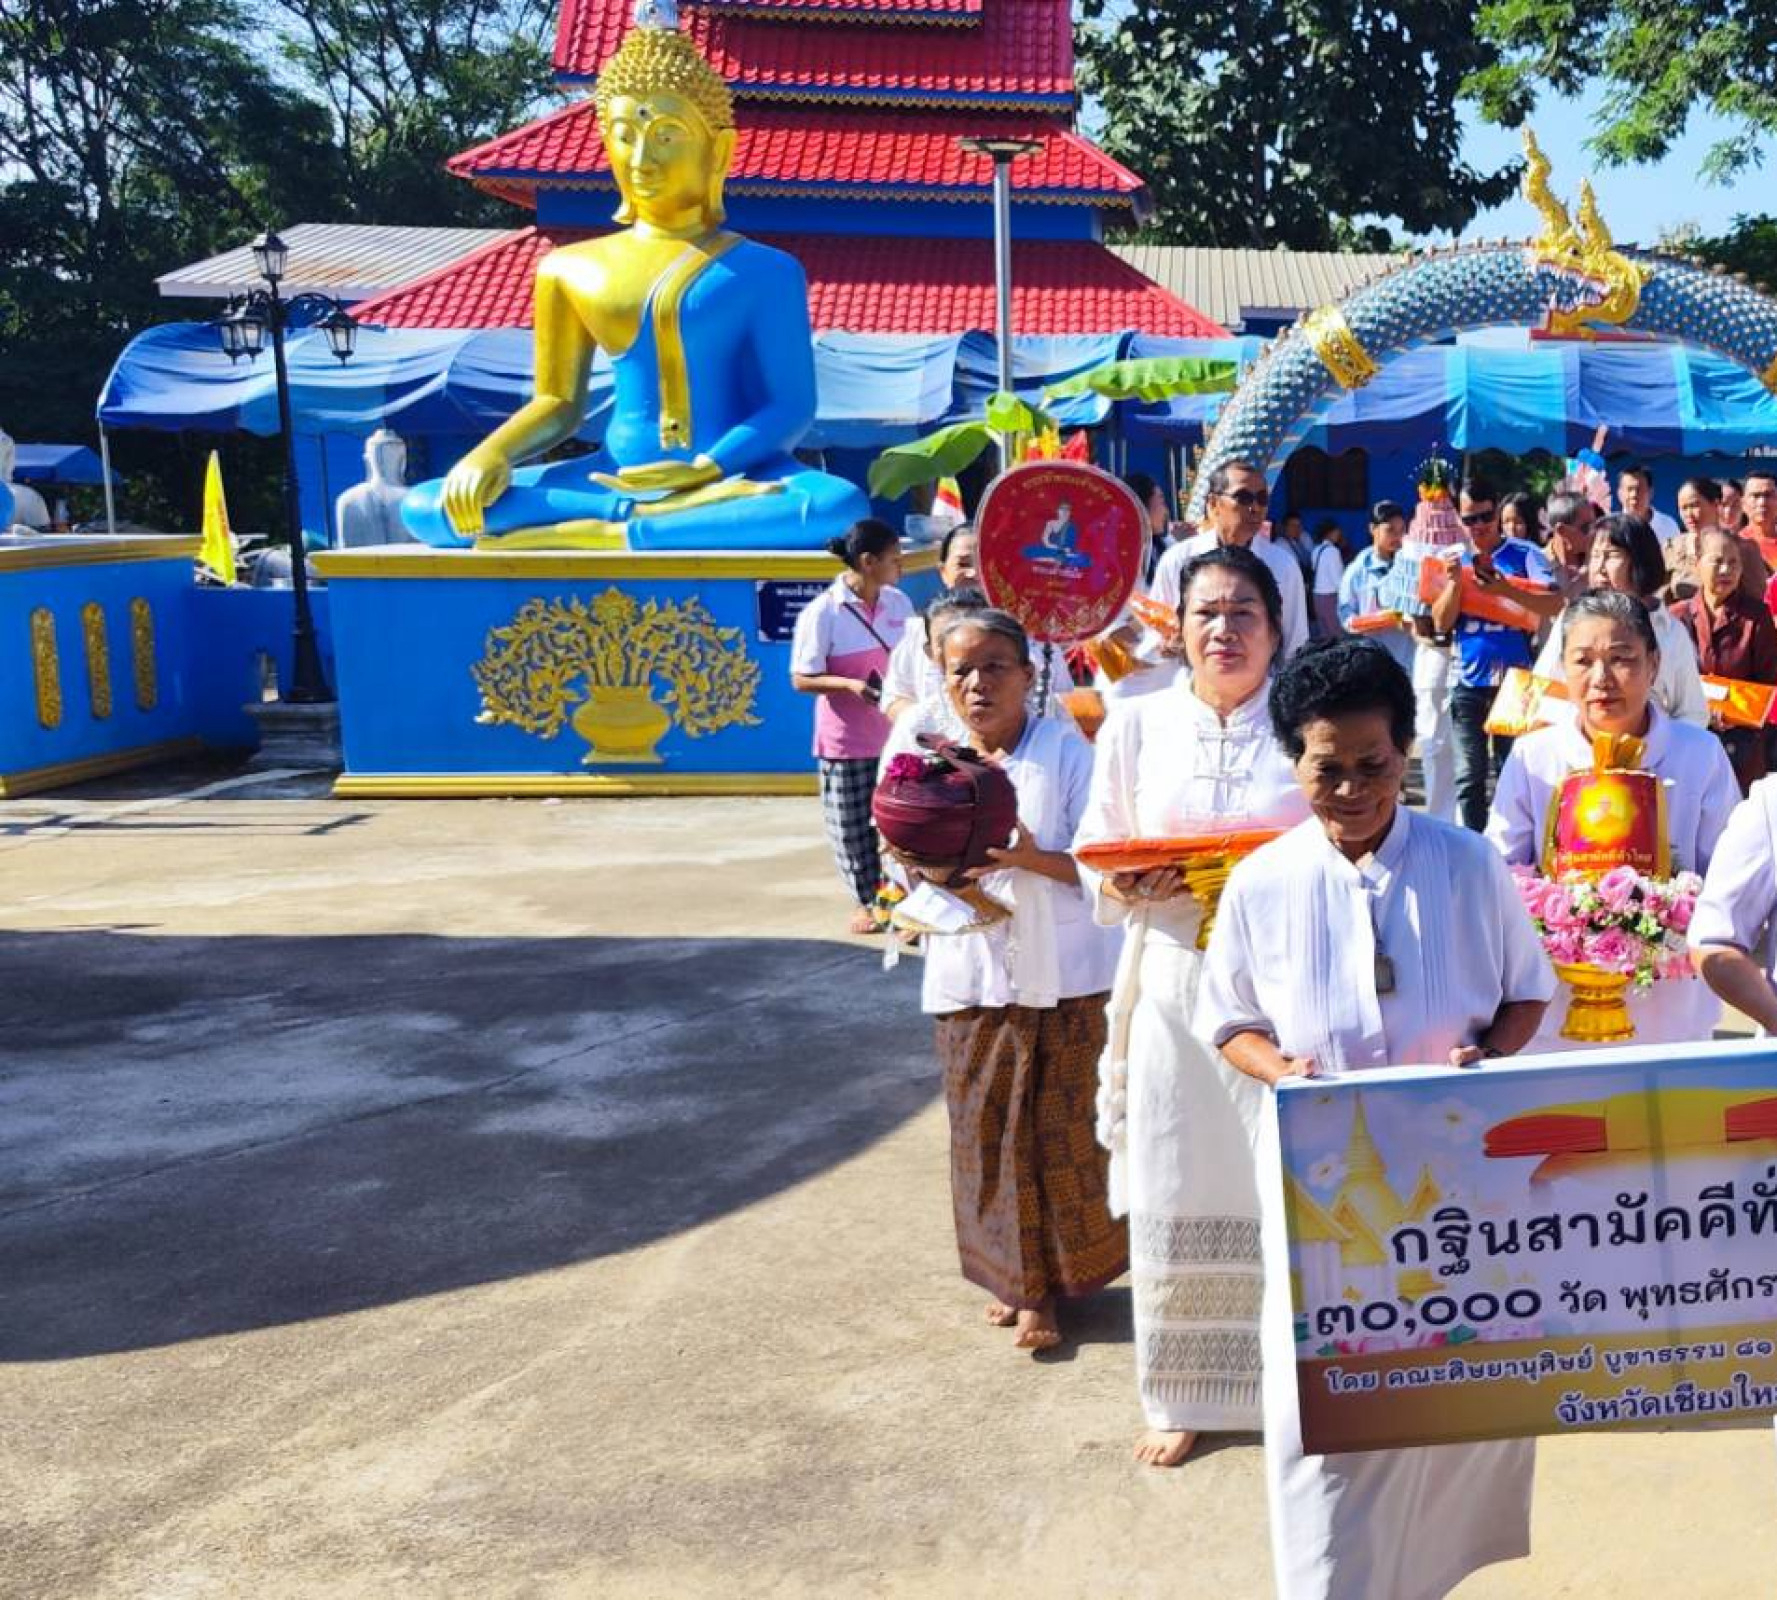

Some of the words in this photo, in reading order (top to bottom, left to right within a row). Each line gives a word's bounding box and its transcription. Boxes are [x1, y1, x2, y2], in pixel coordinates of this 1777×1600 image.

[1315, 1289, 1542, 1336] ๓๐,๐๐๐
[1560, 1281, 1607, 1314] วัด
[1327, 1369, 1377, 1393] โดย
[1387, 1346, 1594, 1387] คณะศิษยานุศิษย์
